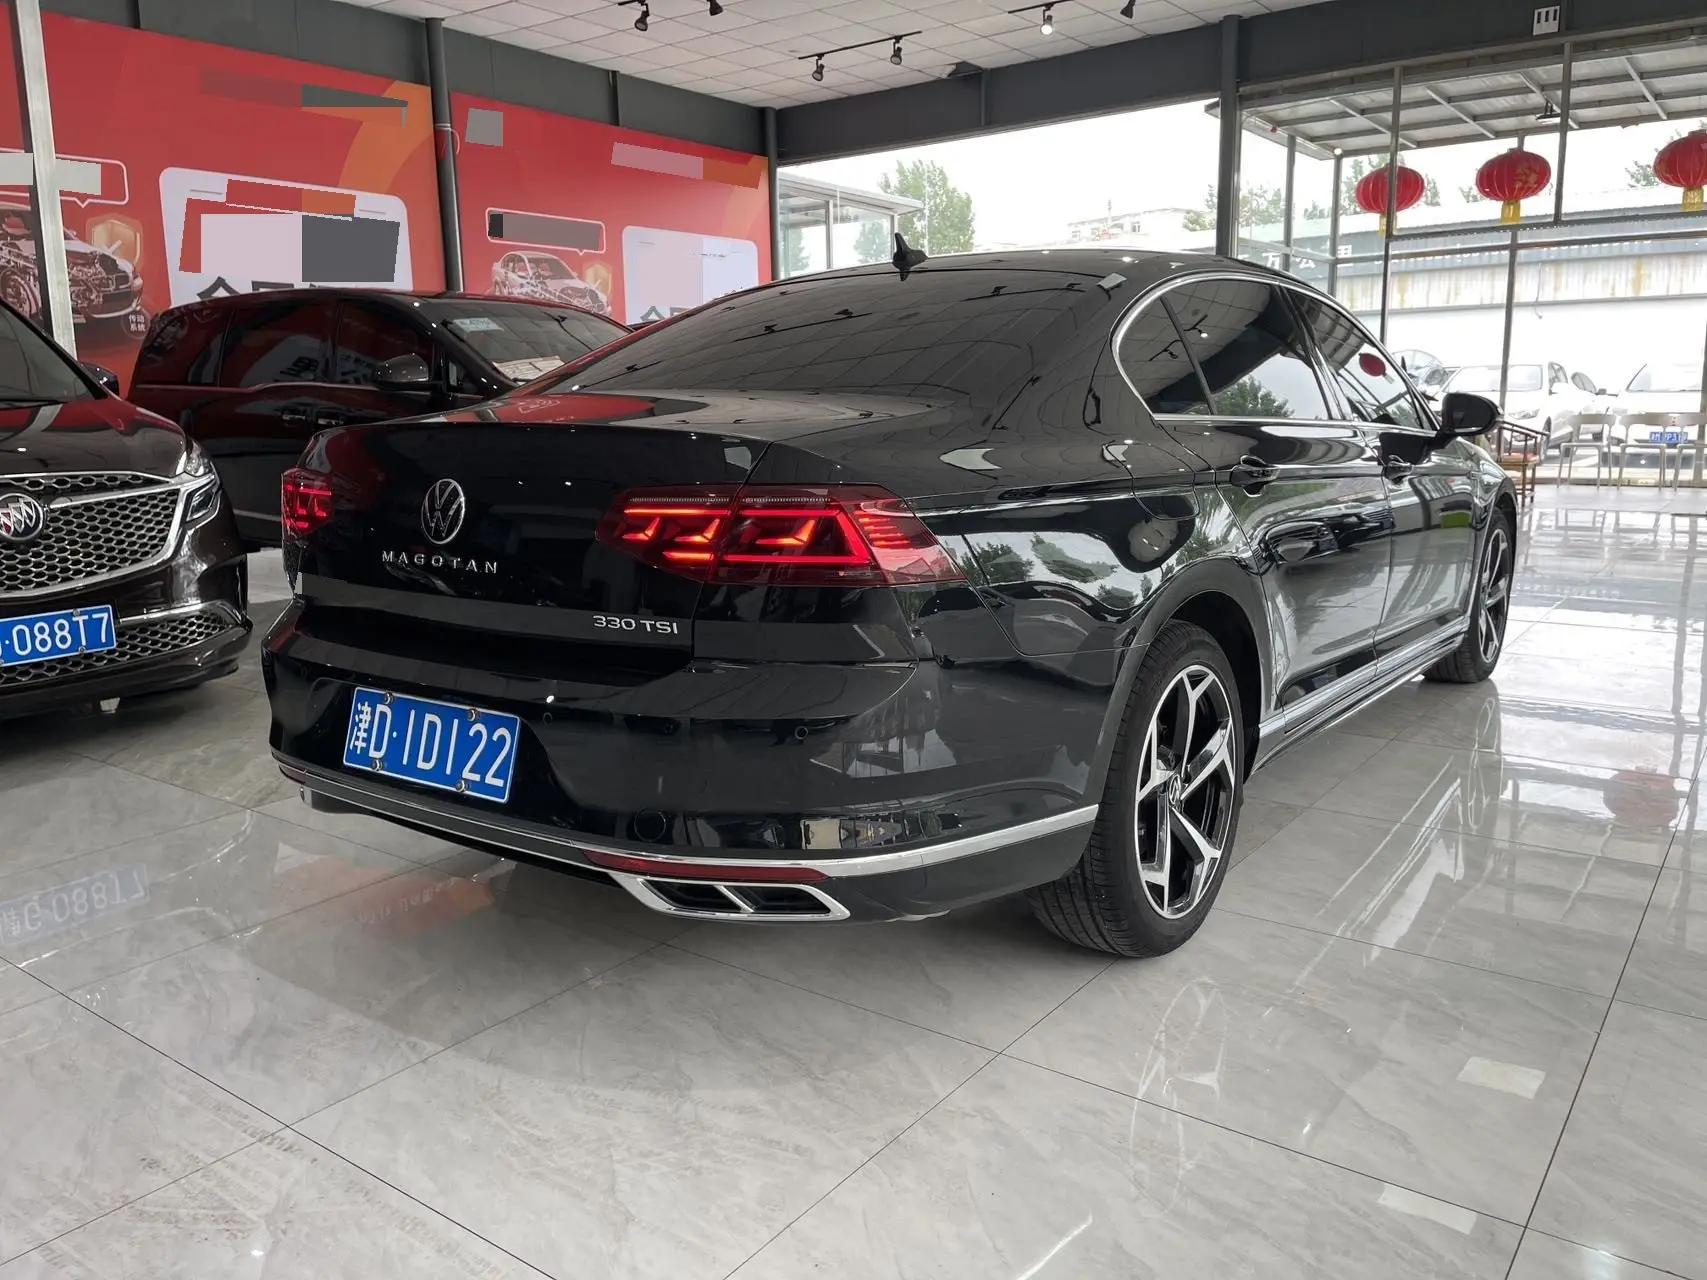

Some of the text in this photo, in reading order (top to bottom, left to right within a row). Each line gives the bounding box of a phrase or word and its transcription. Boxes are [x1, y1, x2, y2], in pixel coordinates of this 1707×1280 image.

[382, 550, 497, 574] MAGOTAN
[0, 612, 109, 657] ·088T7
[593, 615, 678, 635] 330 TSI
